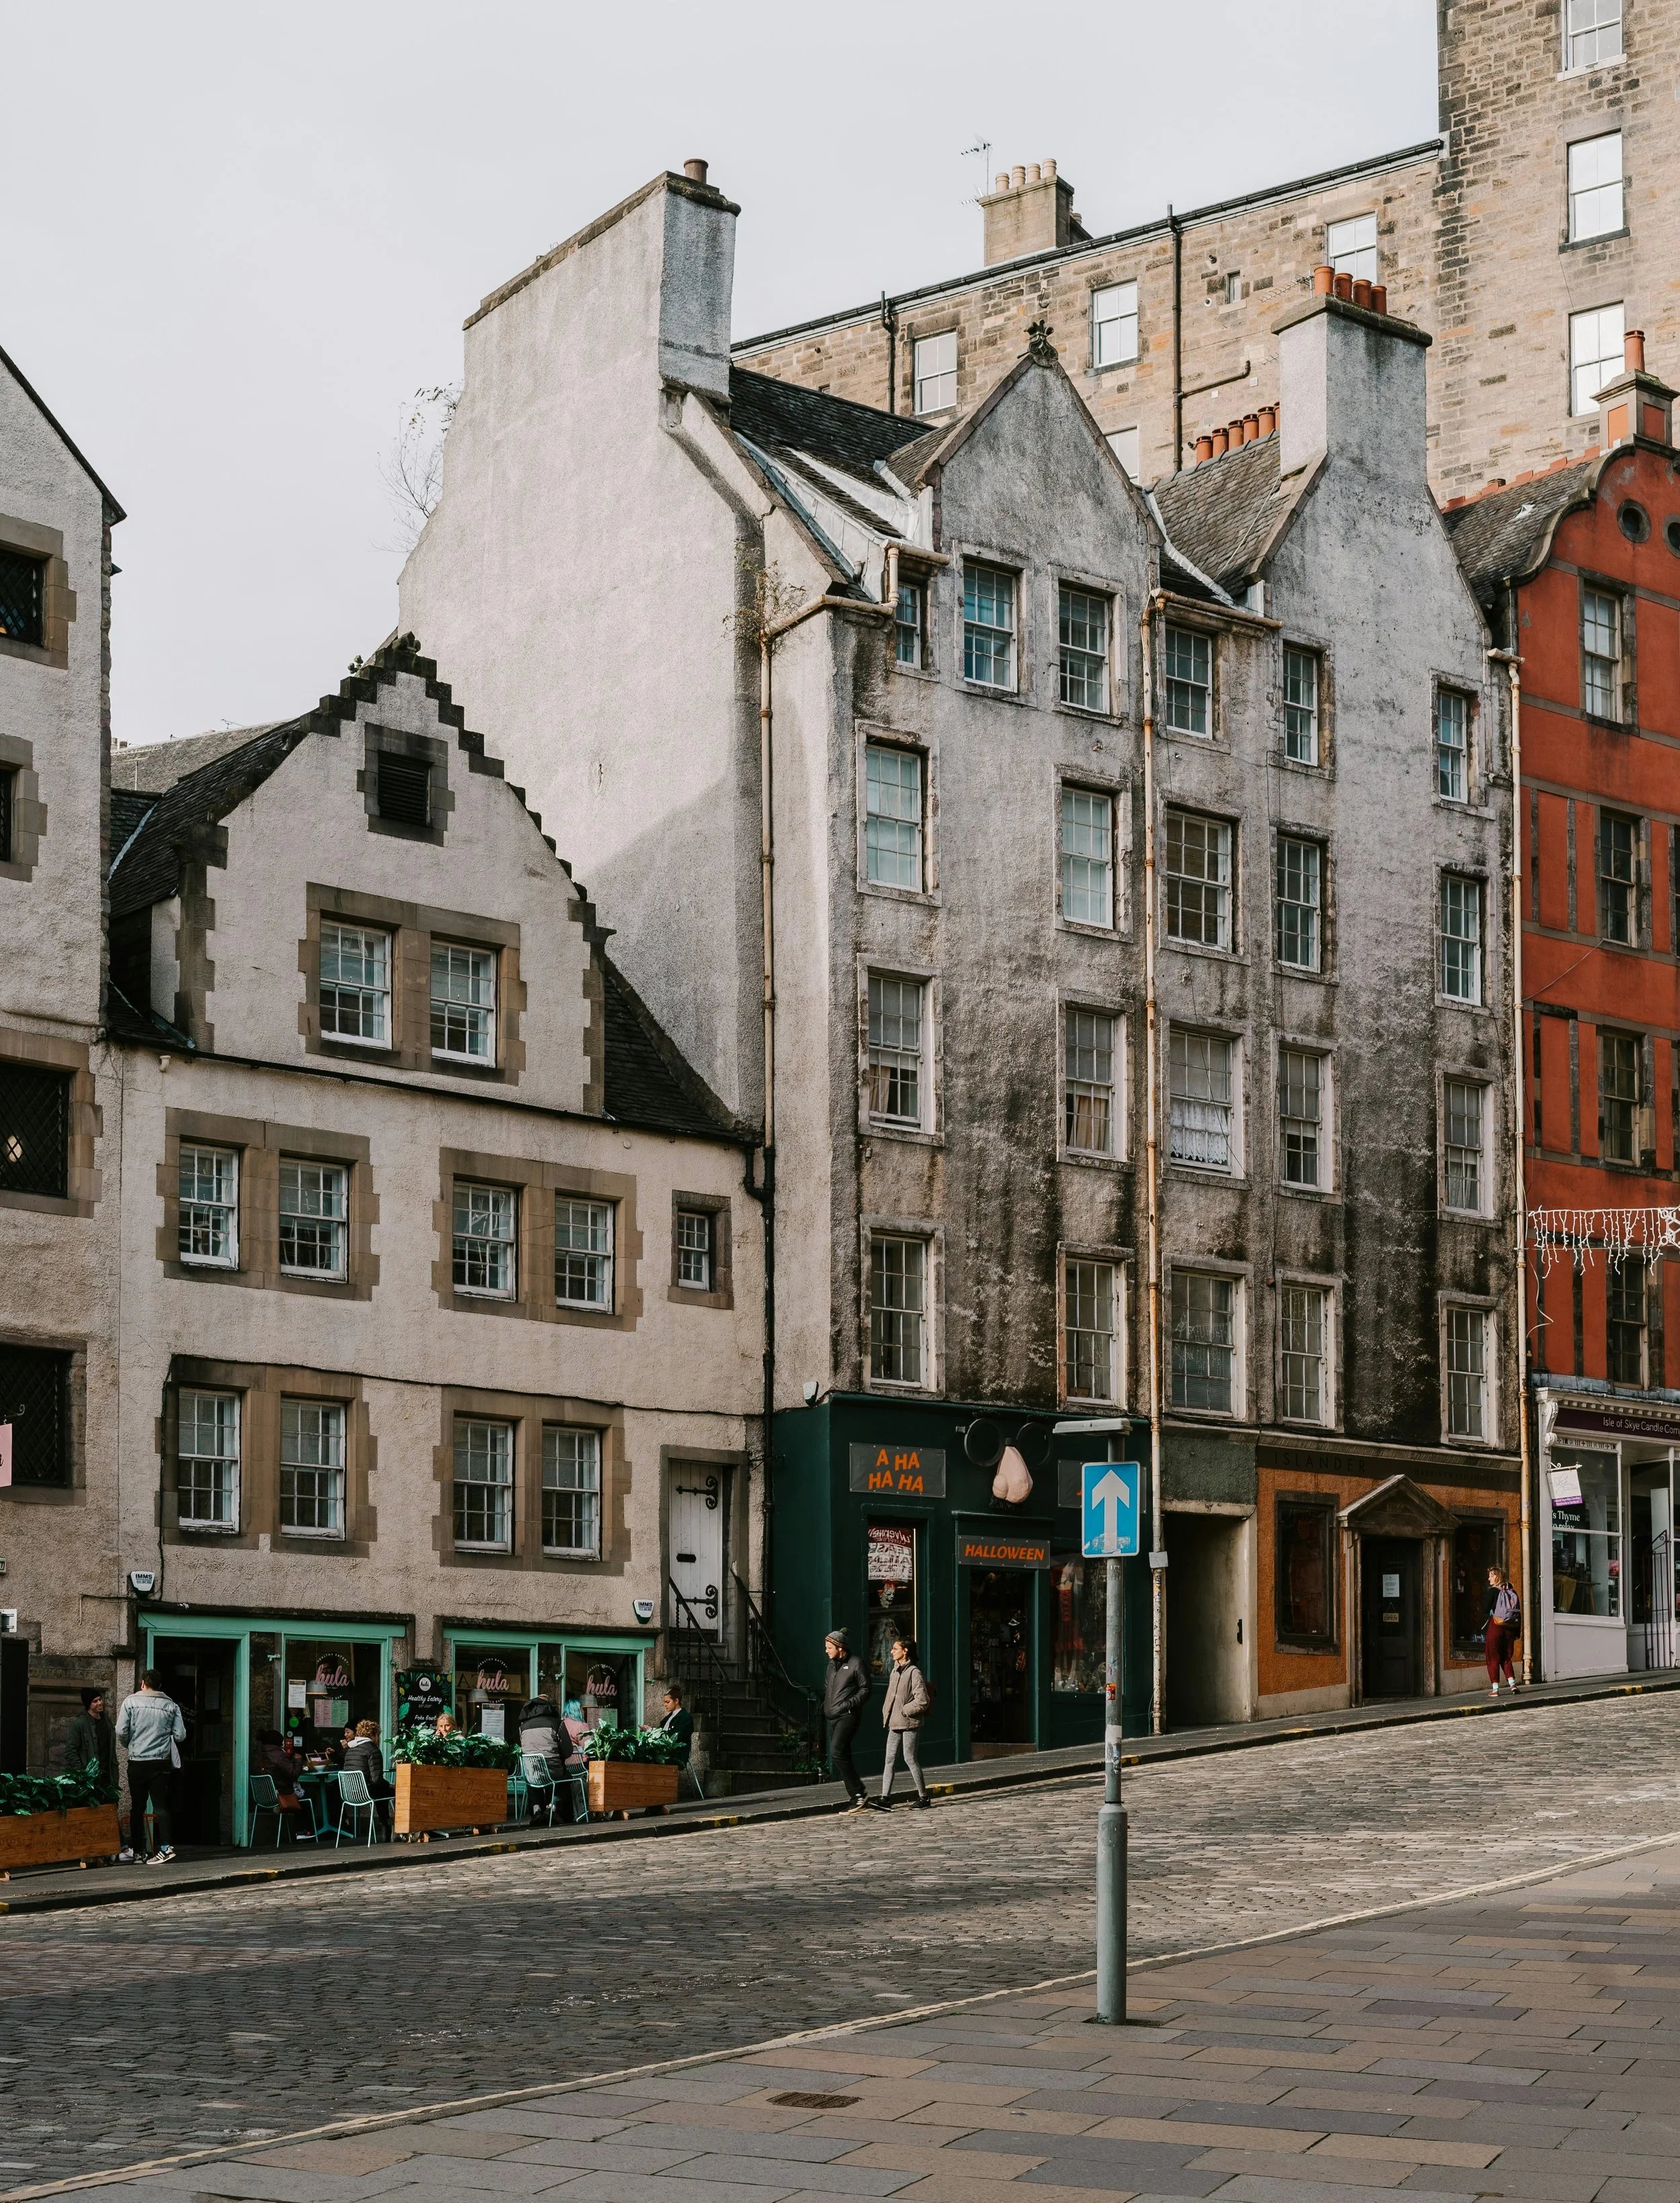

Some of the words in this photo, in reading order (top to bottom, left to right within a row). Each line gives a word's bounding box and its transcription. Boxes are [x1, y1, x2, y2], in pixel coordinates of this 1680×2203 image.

[1603, 1417, 1614, 1427] Isle
[1616, 1419, 1623, 1428] of
[1624, 1419, 1640, 1431] Skye
[1640, 1421, 1663, 1433] Candle
[1664, 1424, 1680, 1437] Com
[876, 1448, 890, 1467] A
[894, 1451, 920, 1471] HA
[1275, 1452, 1366, 1474] ISLANDER
[868, 1470, 893, 1490] HA
[898, 1474, 923, 1493] HA
[1557, 1511, 1580, 1522] Thyme
[964, 1544, 1045, 1561] HALLOWEEN
[315, 1664, 349, 1687] hula
[476, 1669, 509, 1691] hula
[586, 1675, 618, 1696] hula
[408, 1695, 426, 1704] Healthy
[427, 1696, 442, 1705] Eatery
[0, 1837, 23, 1845] UICE
